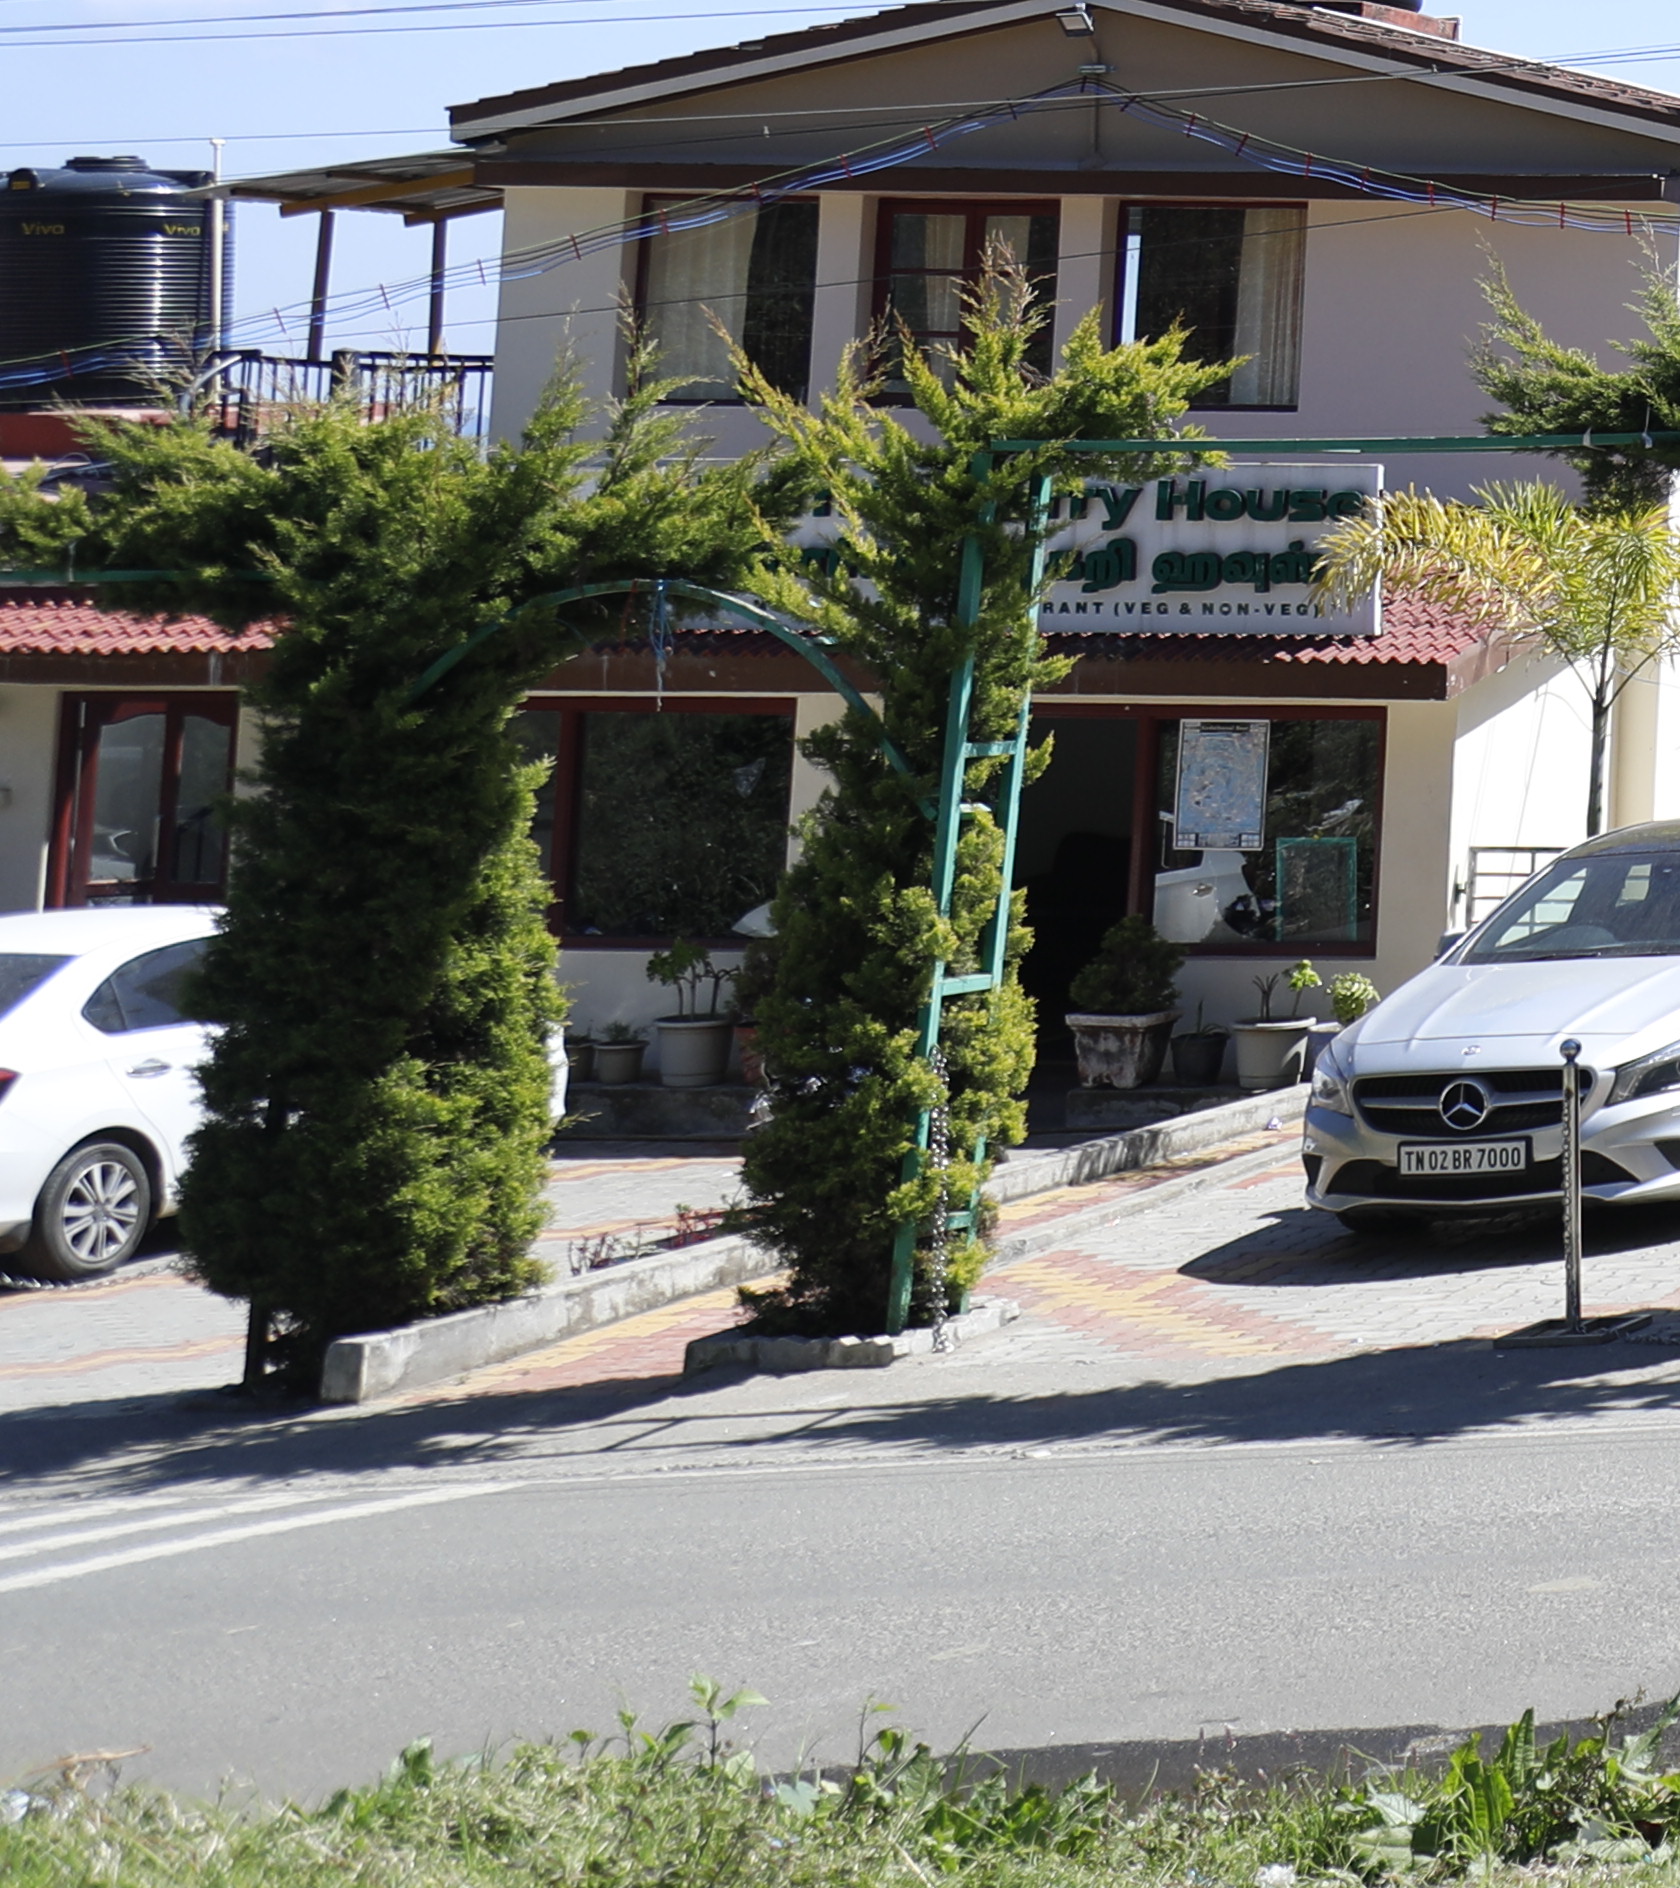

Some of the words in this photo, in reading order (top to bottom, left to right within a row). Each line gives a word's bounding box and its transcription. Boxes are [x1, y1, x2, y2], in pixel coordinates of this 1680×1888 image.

[21, 222, 65, 235] Viva
[163, 223, 200, 236] Viva
[1156, 479, 1367, 523] House
[1113, 602, 1169, 617] (VEG
[1179, 603, 1192, 615] &
[1202, 602, 1319, 618] NON-VEG)
[1405, 1151, 1424, 1171] TN
[1429, 1150, 1449, 1170] 02
[1452, 1149, 1472, 1169] BR
[1477, 1147, 1521, 1169] 7000
